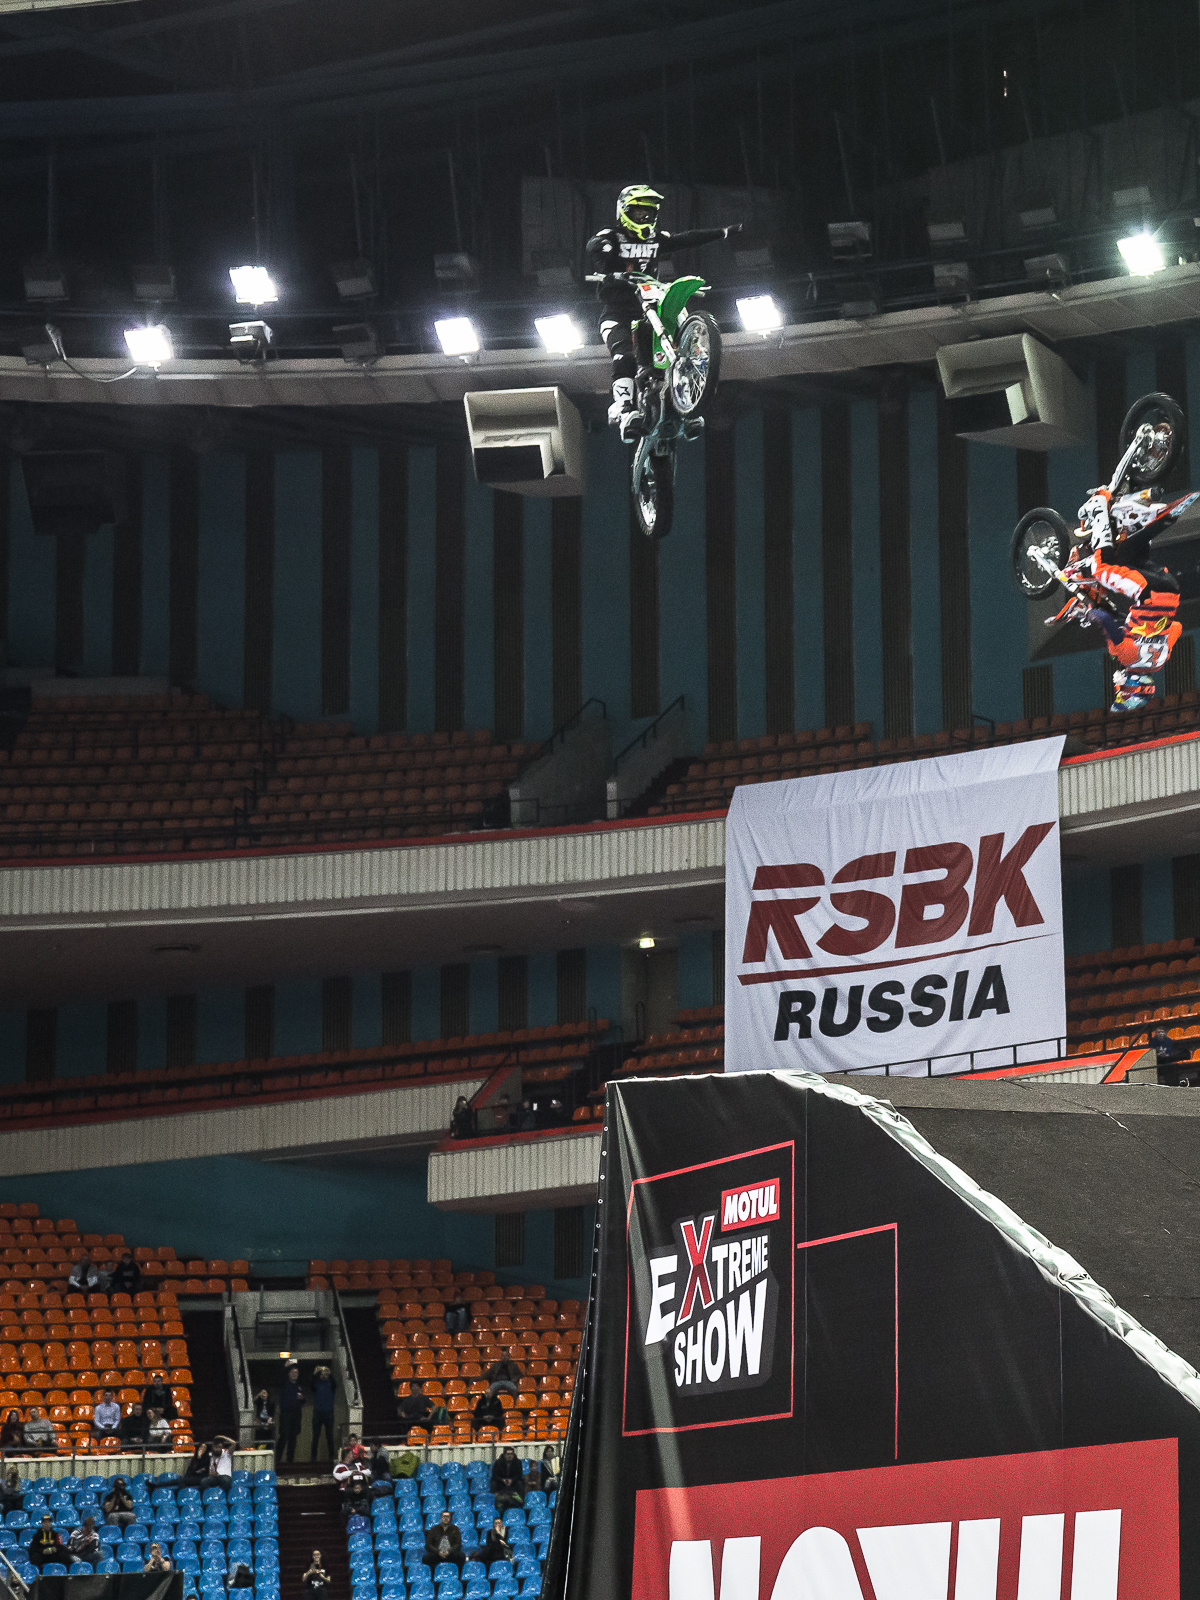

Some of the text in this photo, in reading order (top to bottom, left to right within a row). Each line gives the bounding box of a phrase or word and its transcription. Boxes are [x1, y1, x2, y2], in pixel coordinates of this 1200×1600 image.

[619, 243, 659, 258] SHIFT
[742, 821, 1057, 964] RSBK
[773, 964, 1011, 1042] RUSSIA
[722, 1184, 779, 1226] MOTUL
[645, 1216, 769, 1346] EXTREME
[674, 1278, 768, 1389] SHOW
